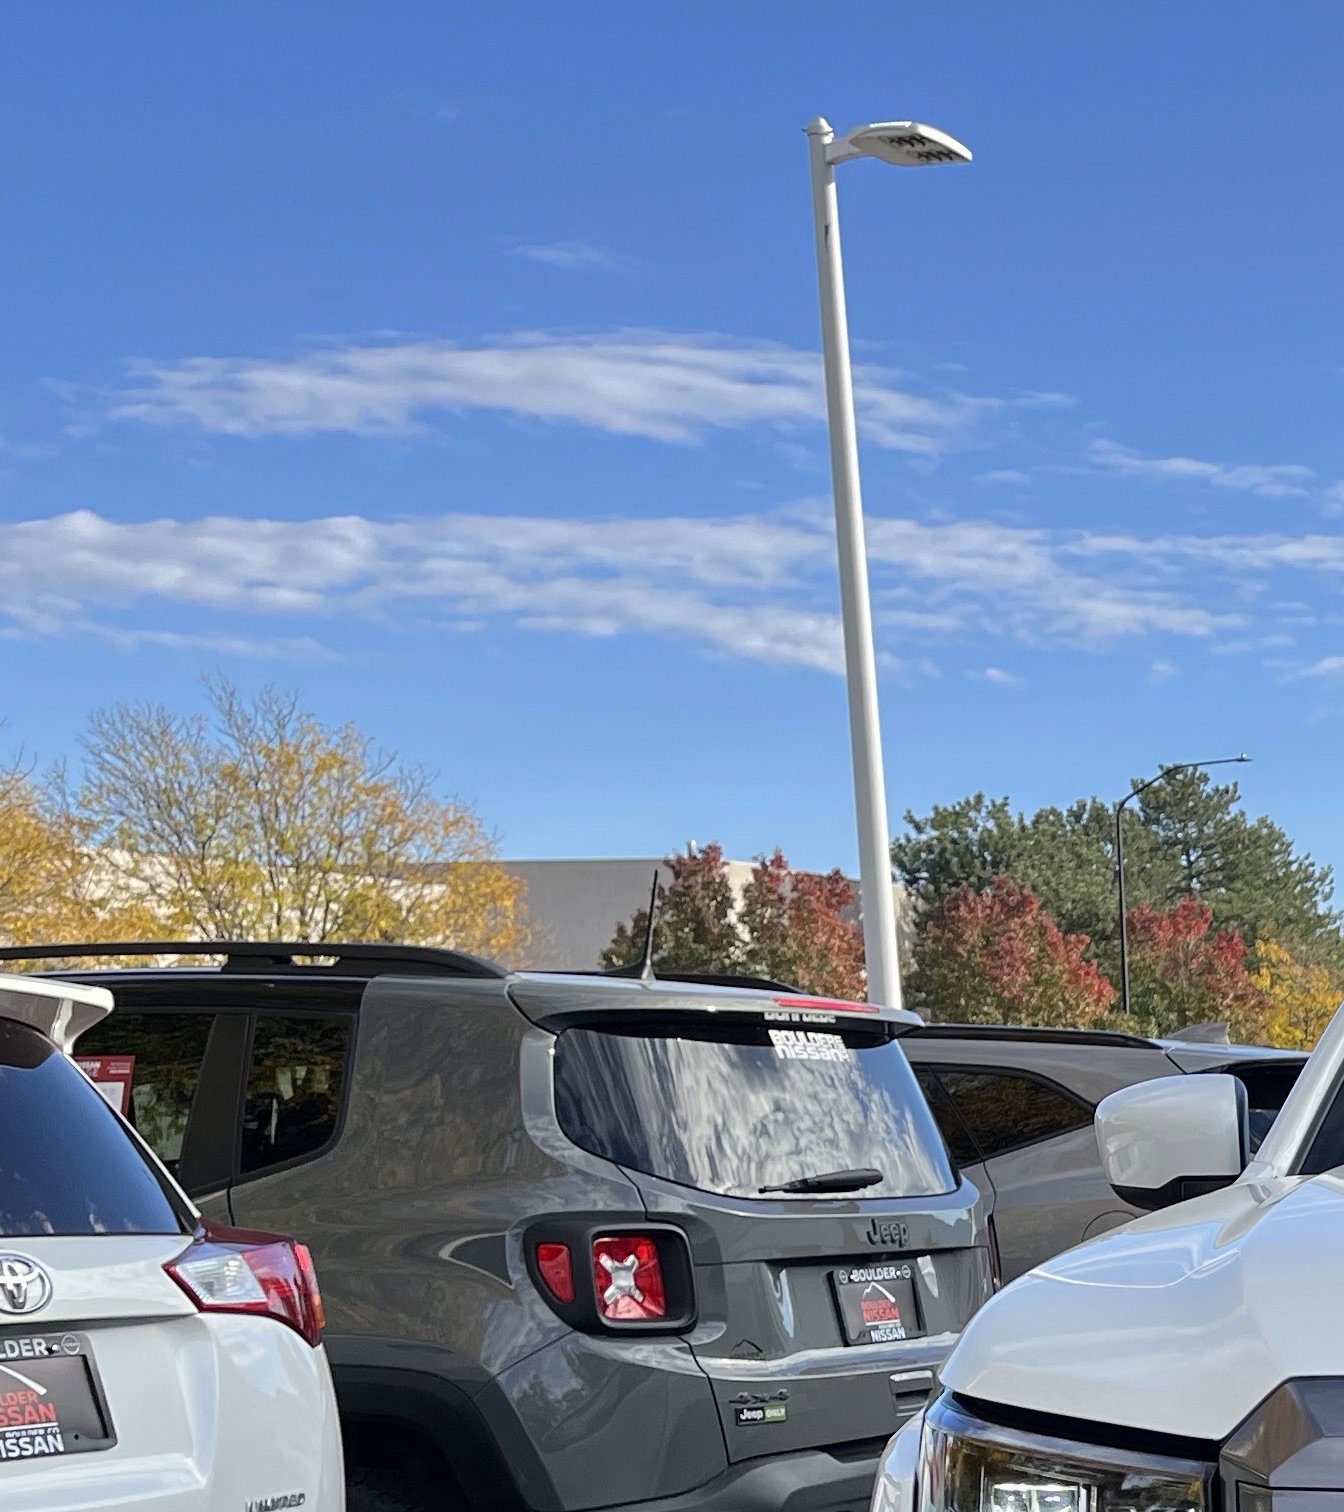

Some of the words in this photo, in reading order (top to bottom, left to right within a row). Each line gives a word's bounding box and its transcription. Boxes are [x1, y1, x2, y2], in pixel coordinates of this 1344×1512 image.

[866, 1218, 909, 1249] Jeep
[852, 1266, 897, 1282] BOULDER
[870, 1326, 906, 1342] NISSAN
